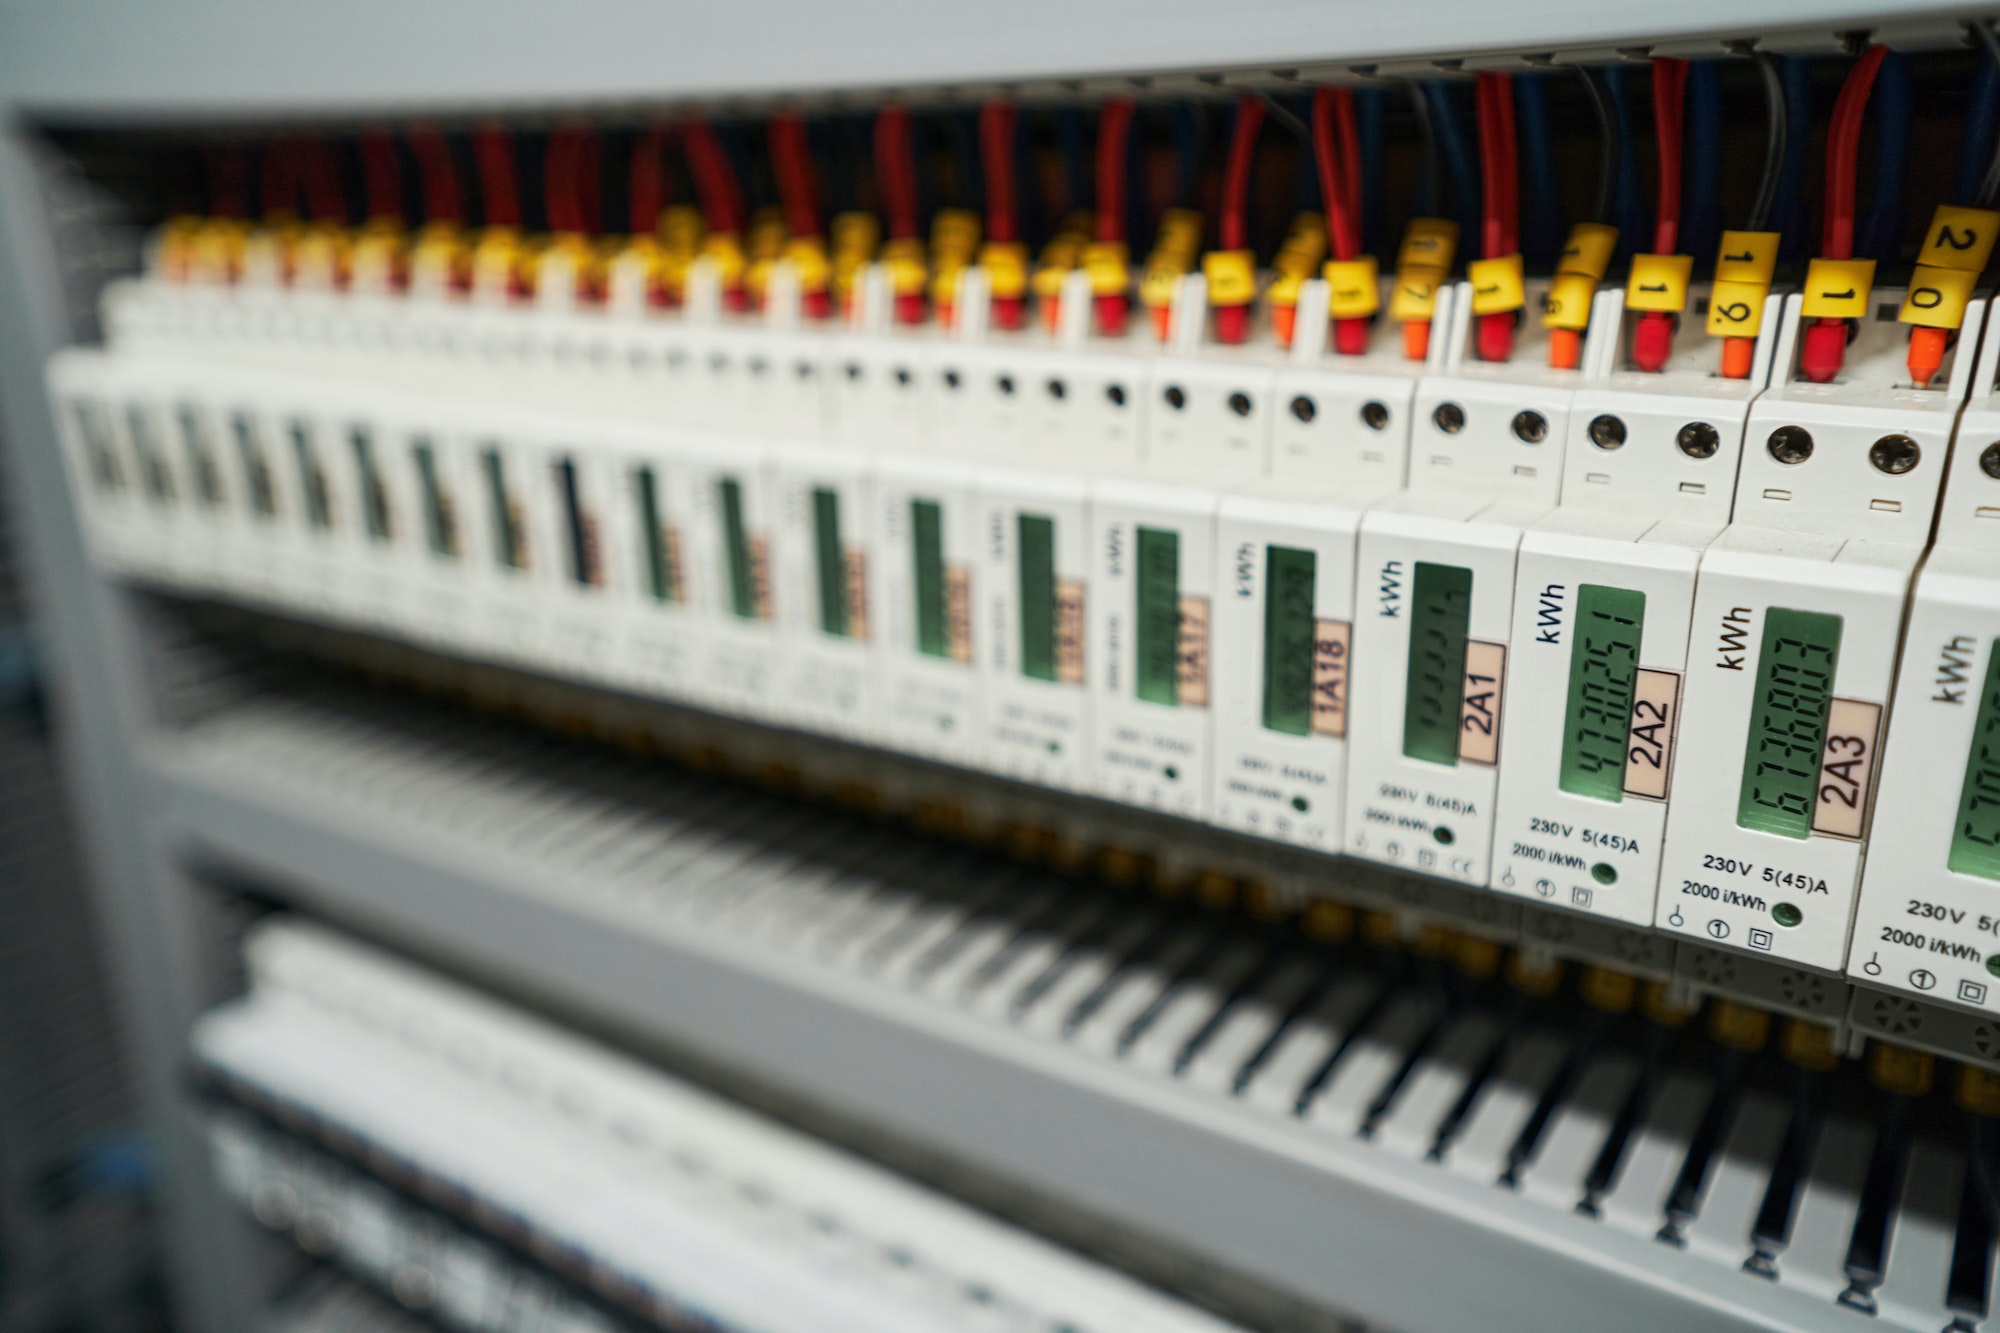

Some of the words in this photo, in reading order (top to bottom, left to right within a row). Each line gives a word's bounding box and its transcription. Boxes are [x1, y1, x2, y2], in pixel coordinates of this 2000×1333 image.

[1638, 282, 1668, 293] 1
[1821, 288, 1855, 300] 1
[1379, 560, 1403, 618] kWh
[1535, 583, 1565, 644] kWh
[1716, 606, 1752, 671] kWh
[1314, 638, 1343, 715] 1A18
[1932, 636, 1978, 705] kWh
[1462, 673, 1496, 736] 2A1
[1753, 637, 1834, 816] 6736803
[1630, 700, 1667, 770] 2A2
[1820, 734, 1867, 809] 2A3
[1582, 829, 1639, 854] 5(45)A
[1682, 880, 1720, 901] 2000
[1722, 889, 1767, 912] i/kWh
[1703, 854, 1753, 877] 230V
[1762, 867, 1829, 895] 5(45)A
[1907, 900, 1966, 924] 230V
[1881, 926, 1926, 949] 2000
[1929, 938, 1981, 963] i/kWh
